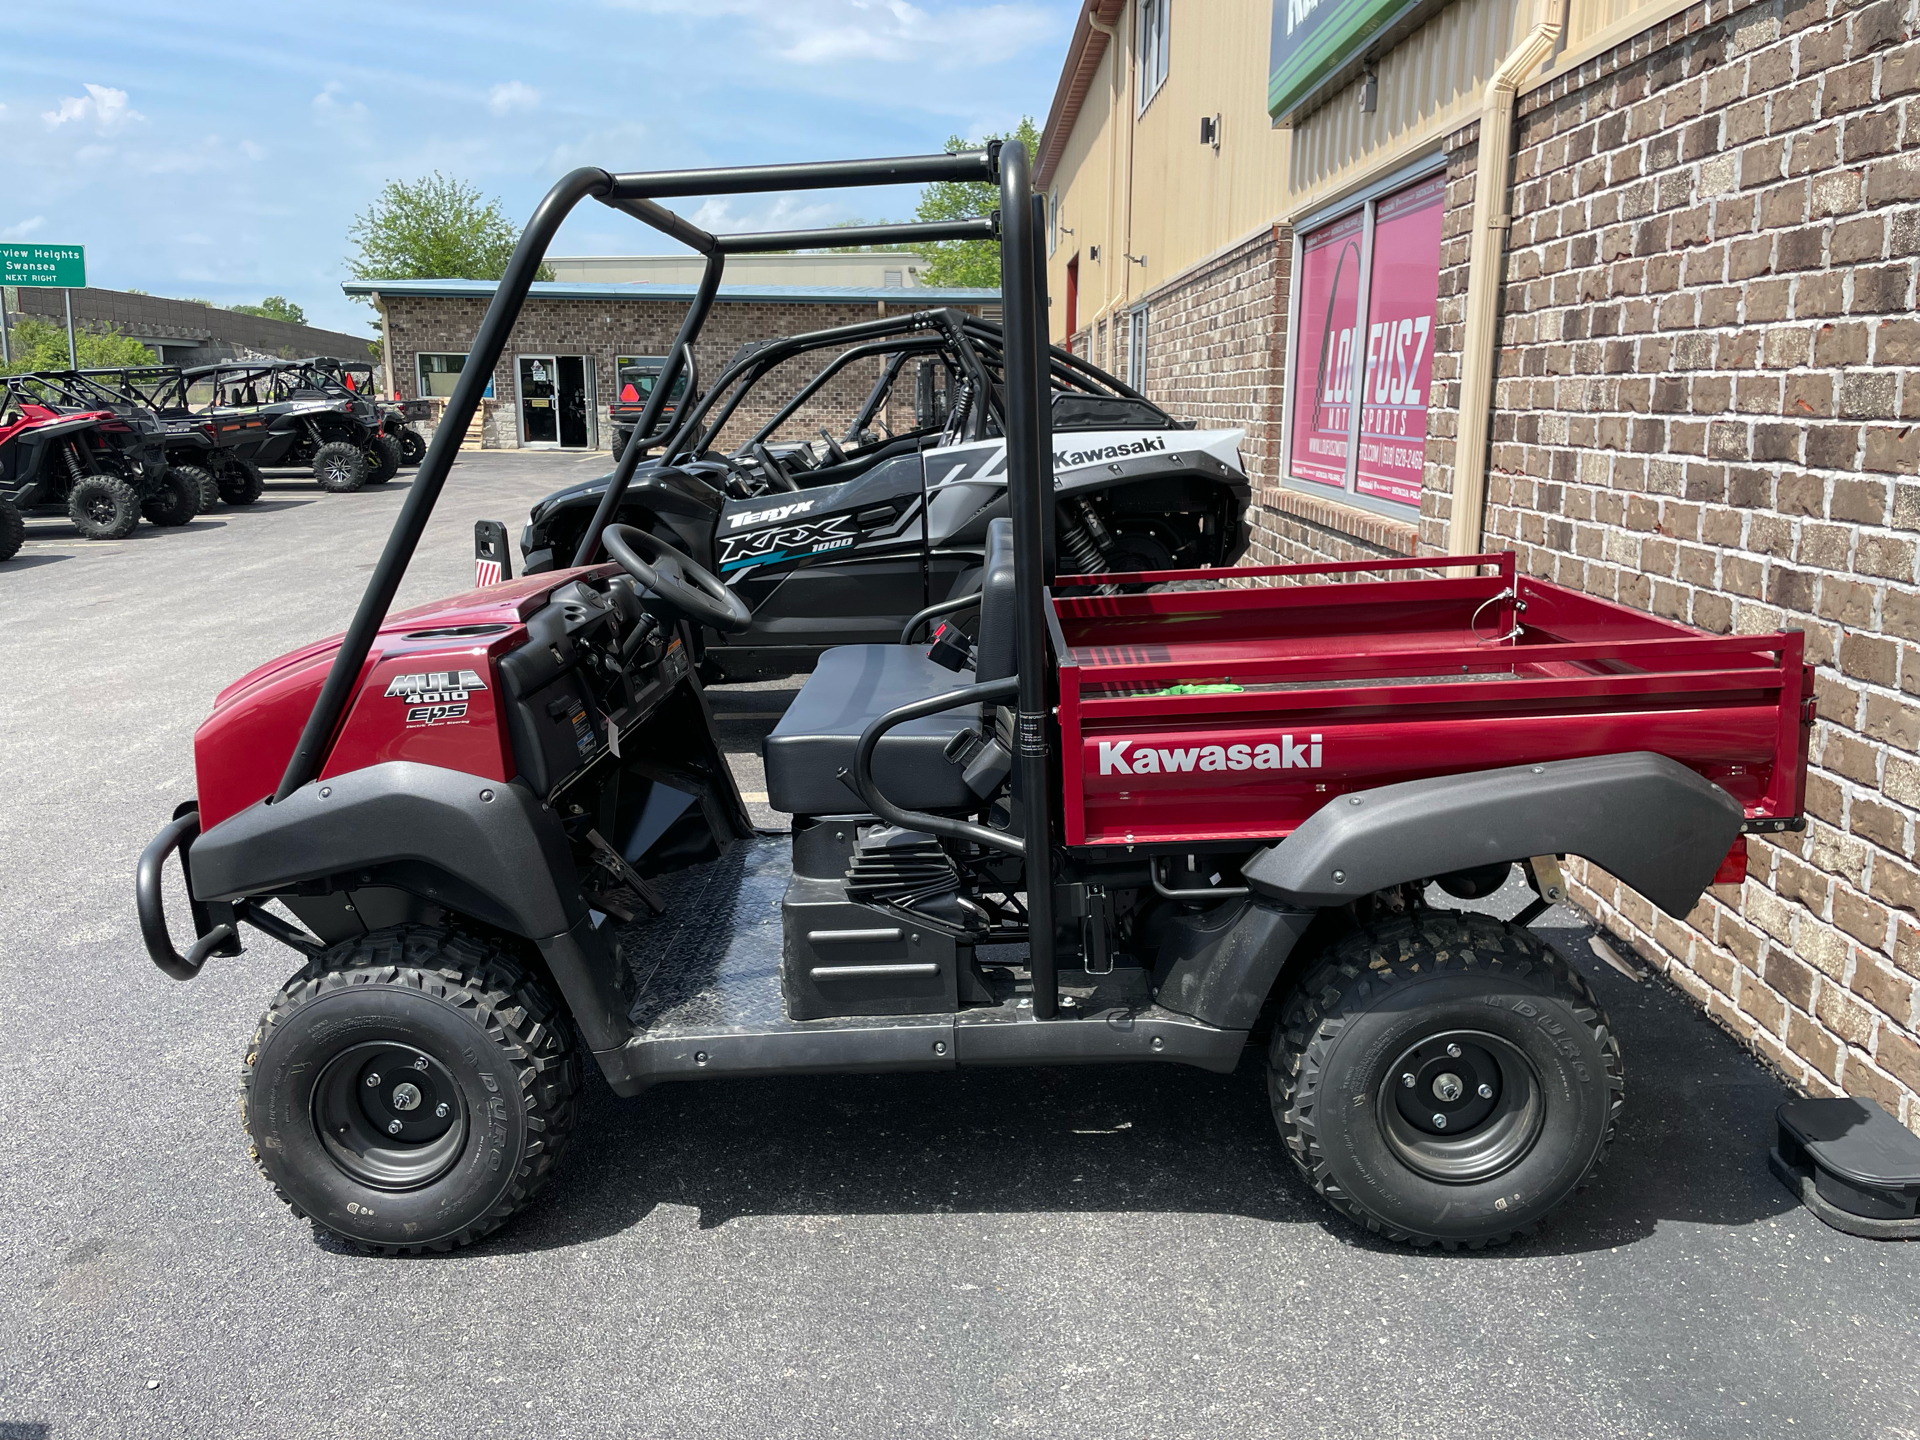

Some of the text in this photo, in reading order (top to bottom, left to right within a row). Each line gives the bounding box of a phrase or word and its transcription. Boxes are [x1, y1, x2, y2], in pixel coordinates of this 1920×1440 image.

[6, 261, 56, 271] Swansea
[34, 249, 80, 261] Heights
[32, 274, 57, 282] RIGHT
[1363, 315, 1431, 405] FUSZ
[1053, 436, 1166, 469] Kawasaki
[719, 515, 857, 563] KRX
[812, 537, 853, 552] 1000
[384, 670, 488, 697] MULE
[405, 691, 469, 704] 4010
[1099, 733, 1323, 776] Kawasaki
[1511, 999, 1591, 1083] DURO
[478, 1071, 508, 1172] DURO
